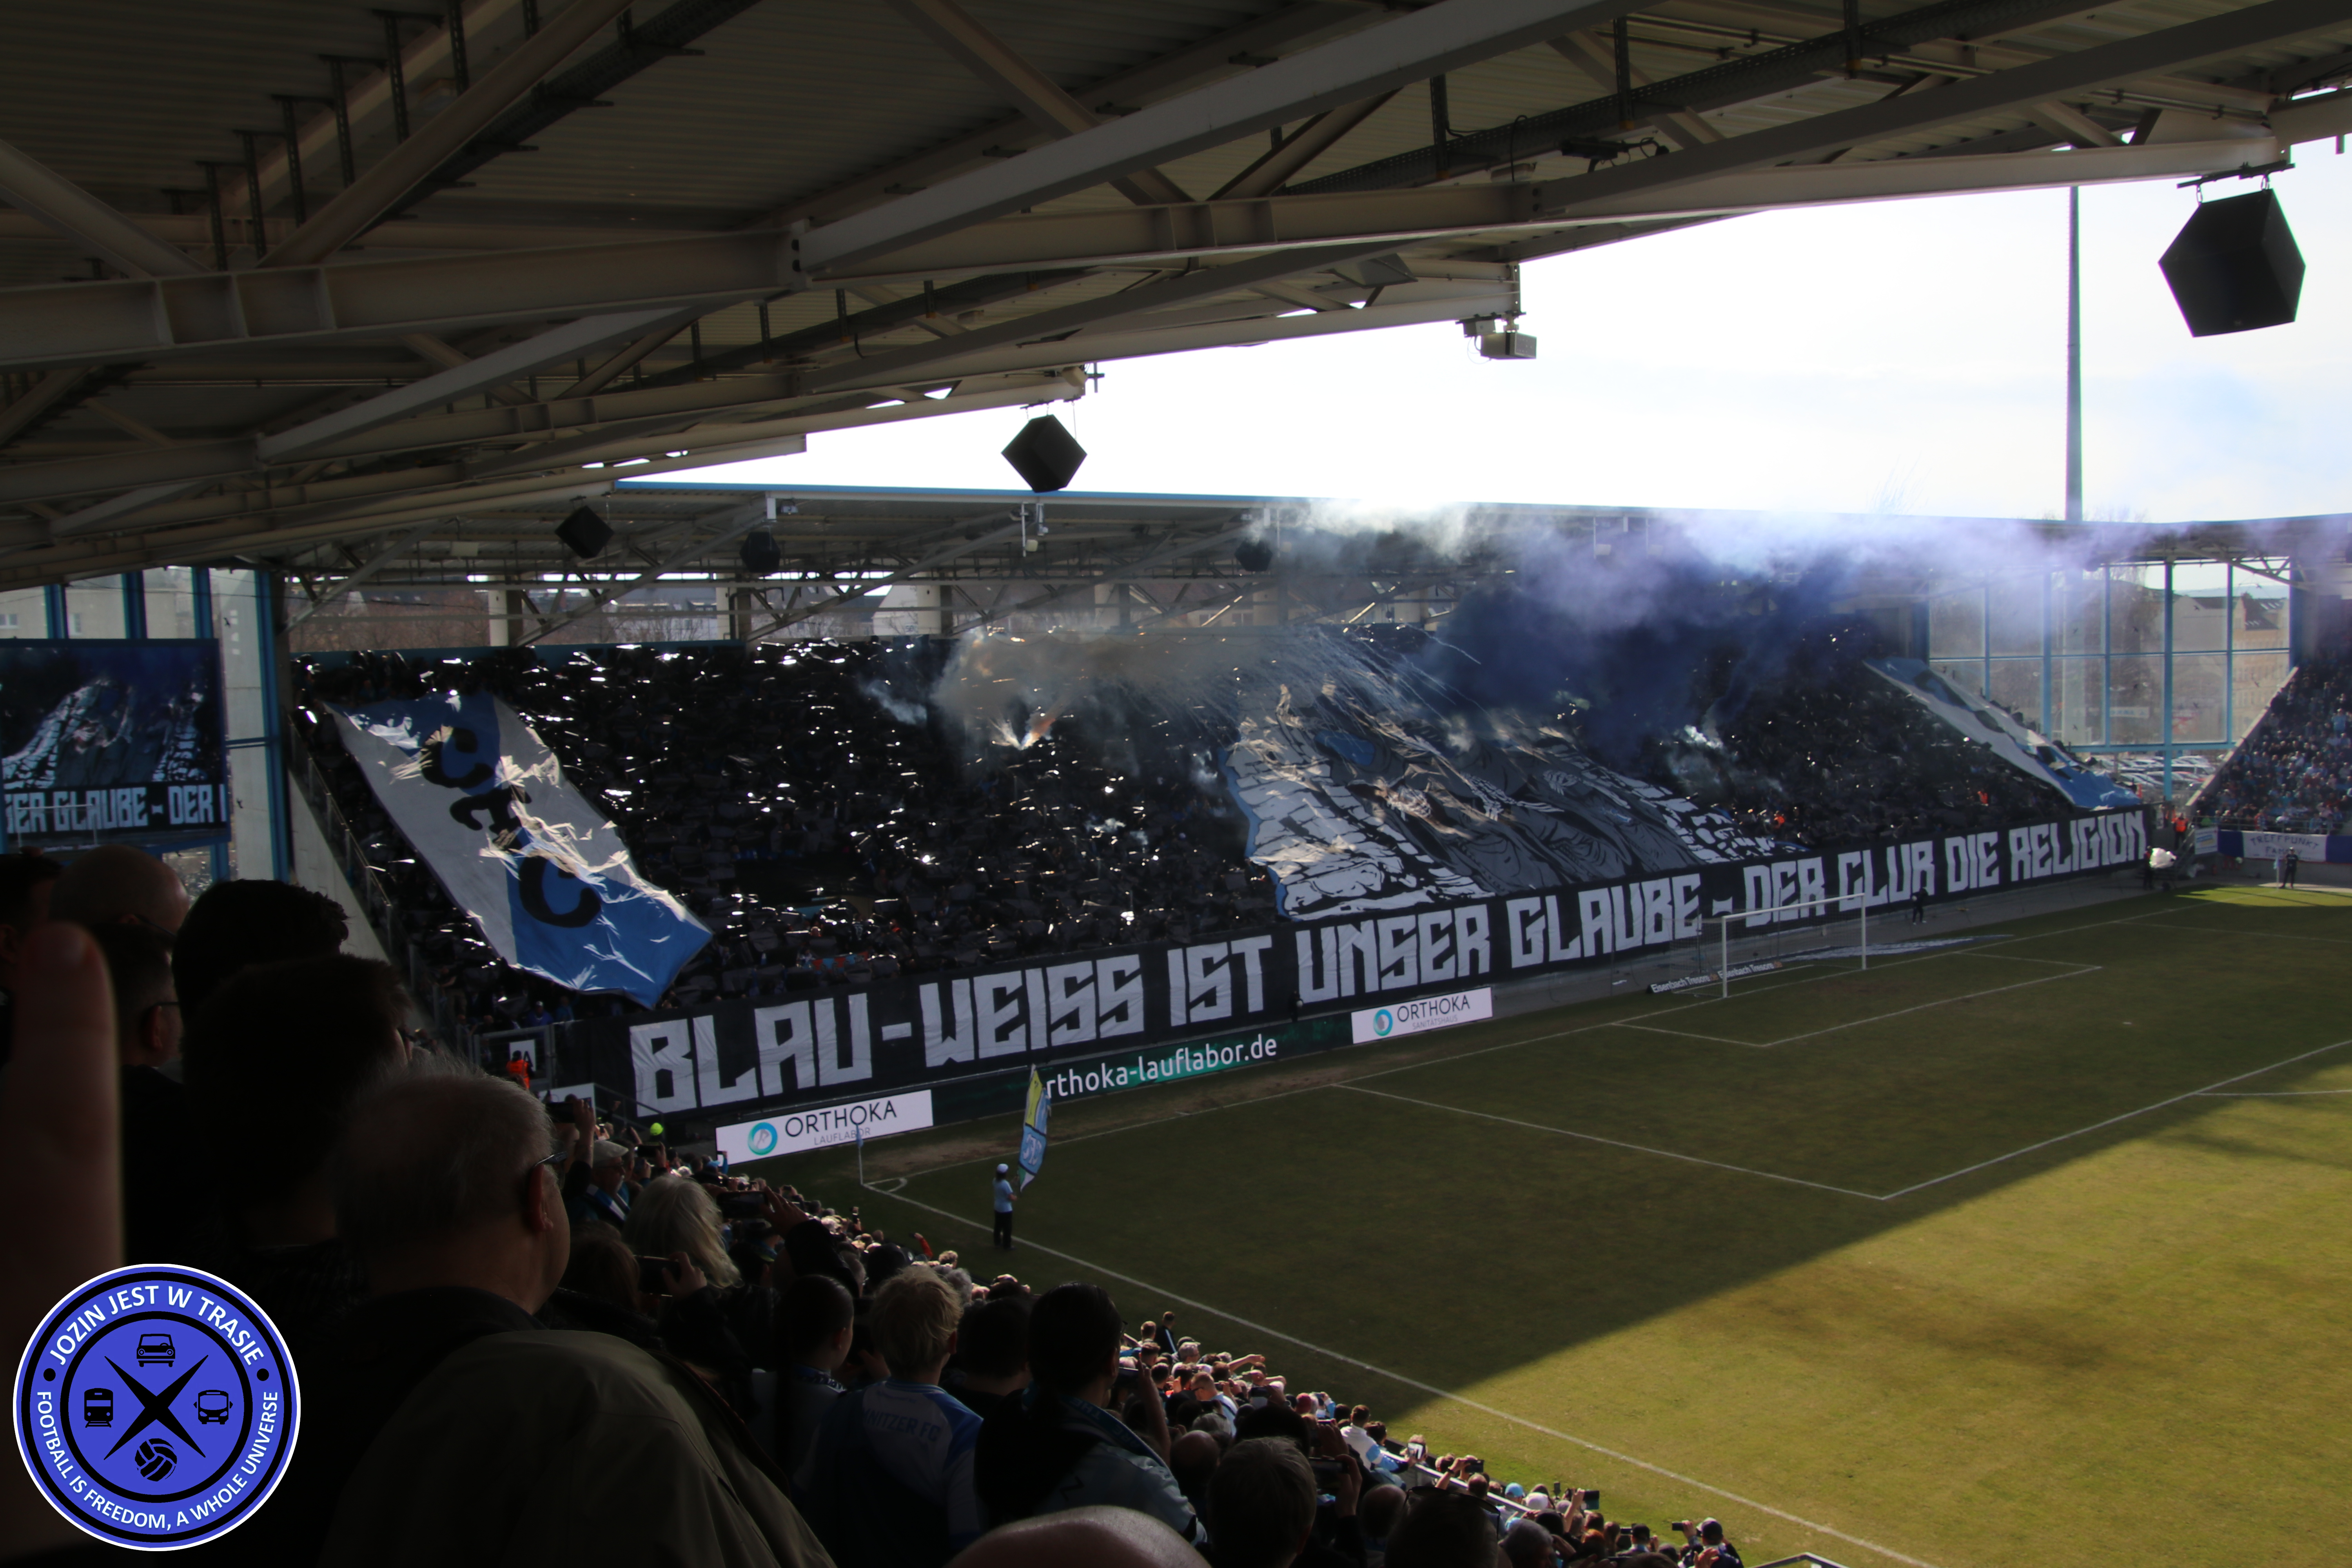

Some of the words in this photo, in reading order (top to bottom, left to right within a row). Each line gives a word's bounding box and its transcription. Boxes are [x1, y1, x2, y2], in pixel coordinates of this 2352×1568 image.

[53, 787, 148, 832] GLAUBE
[169, 784, 214, 824] DER
[1167, 935, 1272, 1027] IST
[1295, 903, 1490, 1003] UNSER
[1506, 873, 1702, 968] GLAUBE
[1744, 856, 1826, 927] DER
[1944, 831, 2000, 893] DIE
[2009, 810, 2148, 882] RELIGION
[1650, 978, 1688, 993] Eisenbach
[1397, 995, 1470, 1022] ORTHOKA
[1045, 1033, 1277, 1099] rthoka-lauflabor.de
[786, 1100, 897, 1137] ORTHOKA
[919, 1422, 941, 1442] FC
